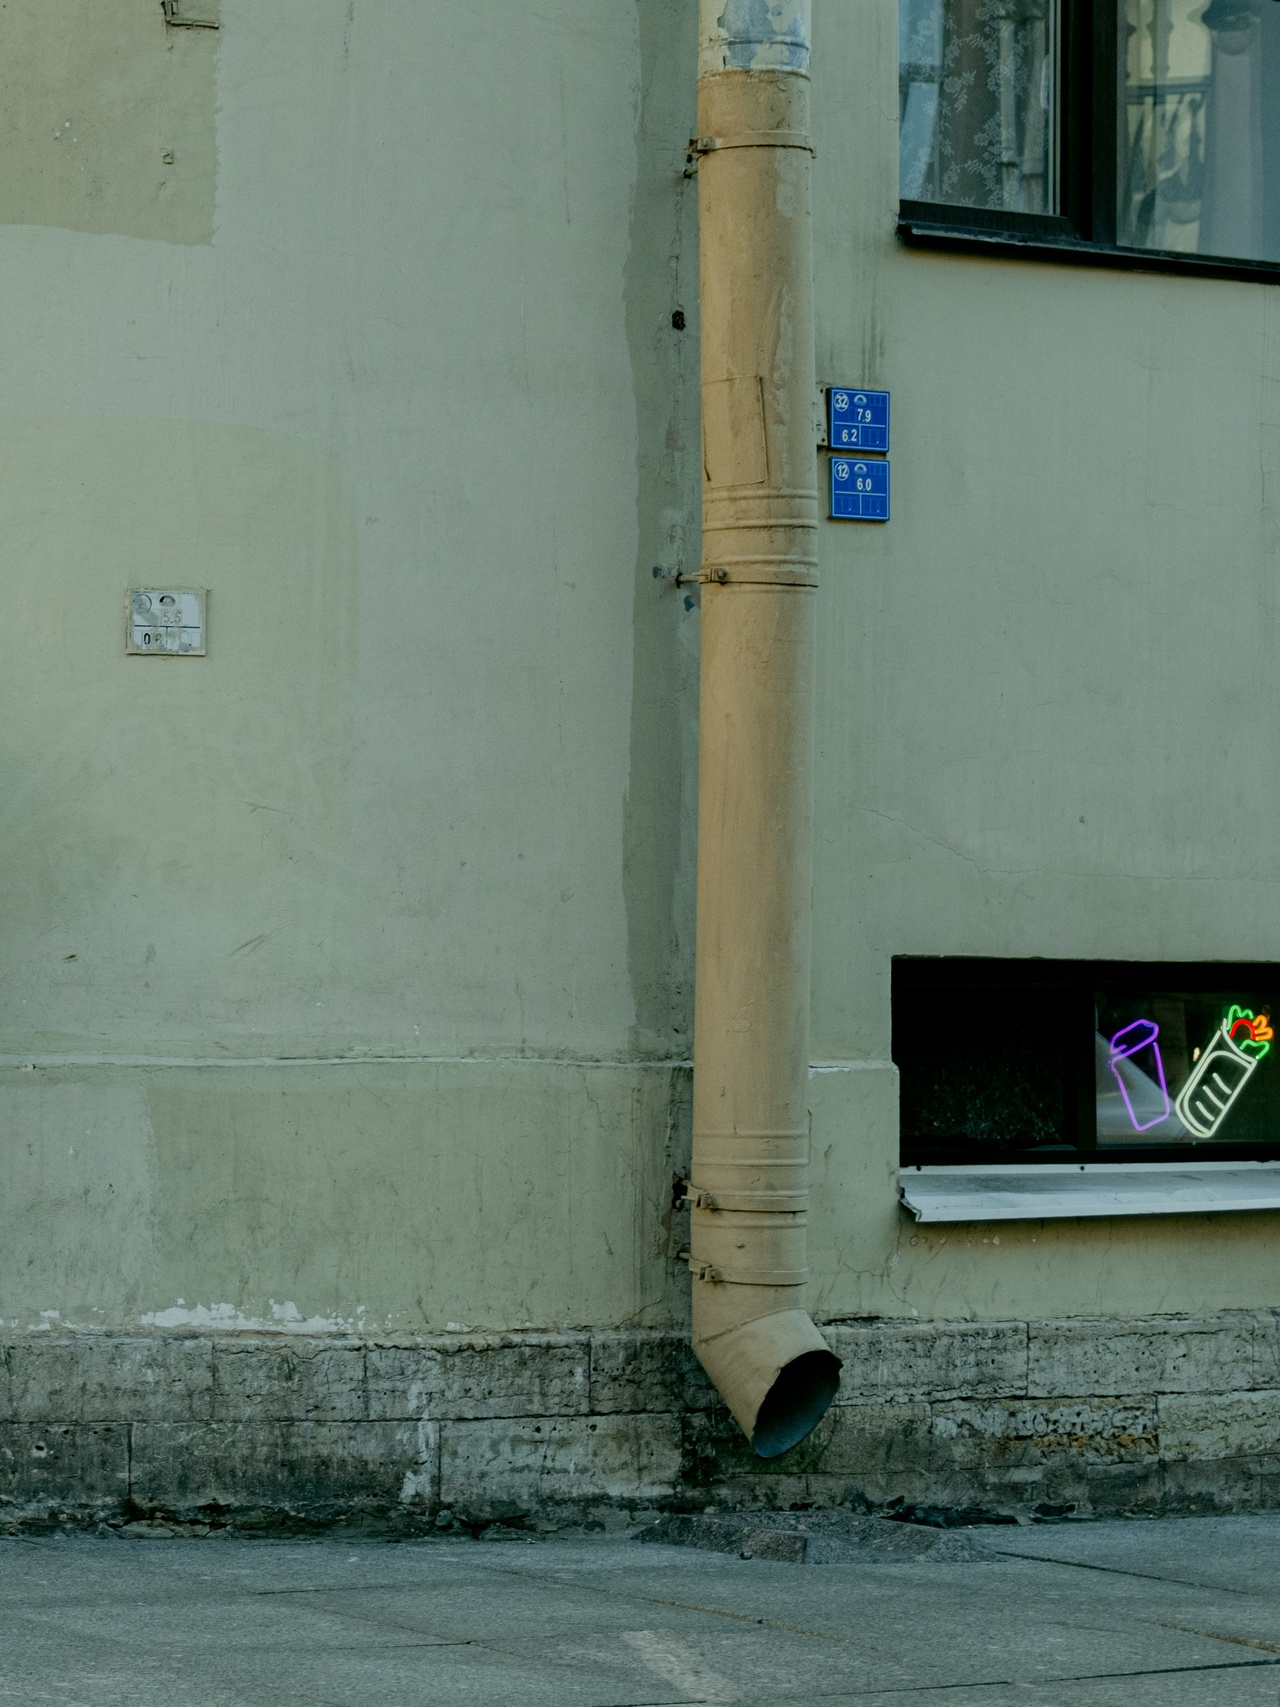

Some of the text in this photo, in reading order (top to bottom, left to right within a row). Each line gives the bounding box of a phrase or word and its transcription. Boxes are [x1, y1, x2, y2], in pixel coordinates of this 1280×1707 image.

[836, 395, 847, 408] 32
[857, 408, 872, 423] 7.9
[842, 428, 857, 442] 6.2
[837, 464, 848, 477] 12
[856, 477, 872, 491] 6.0
[162, 610, 182, 624] 5.5
